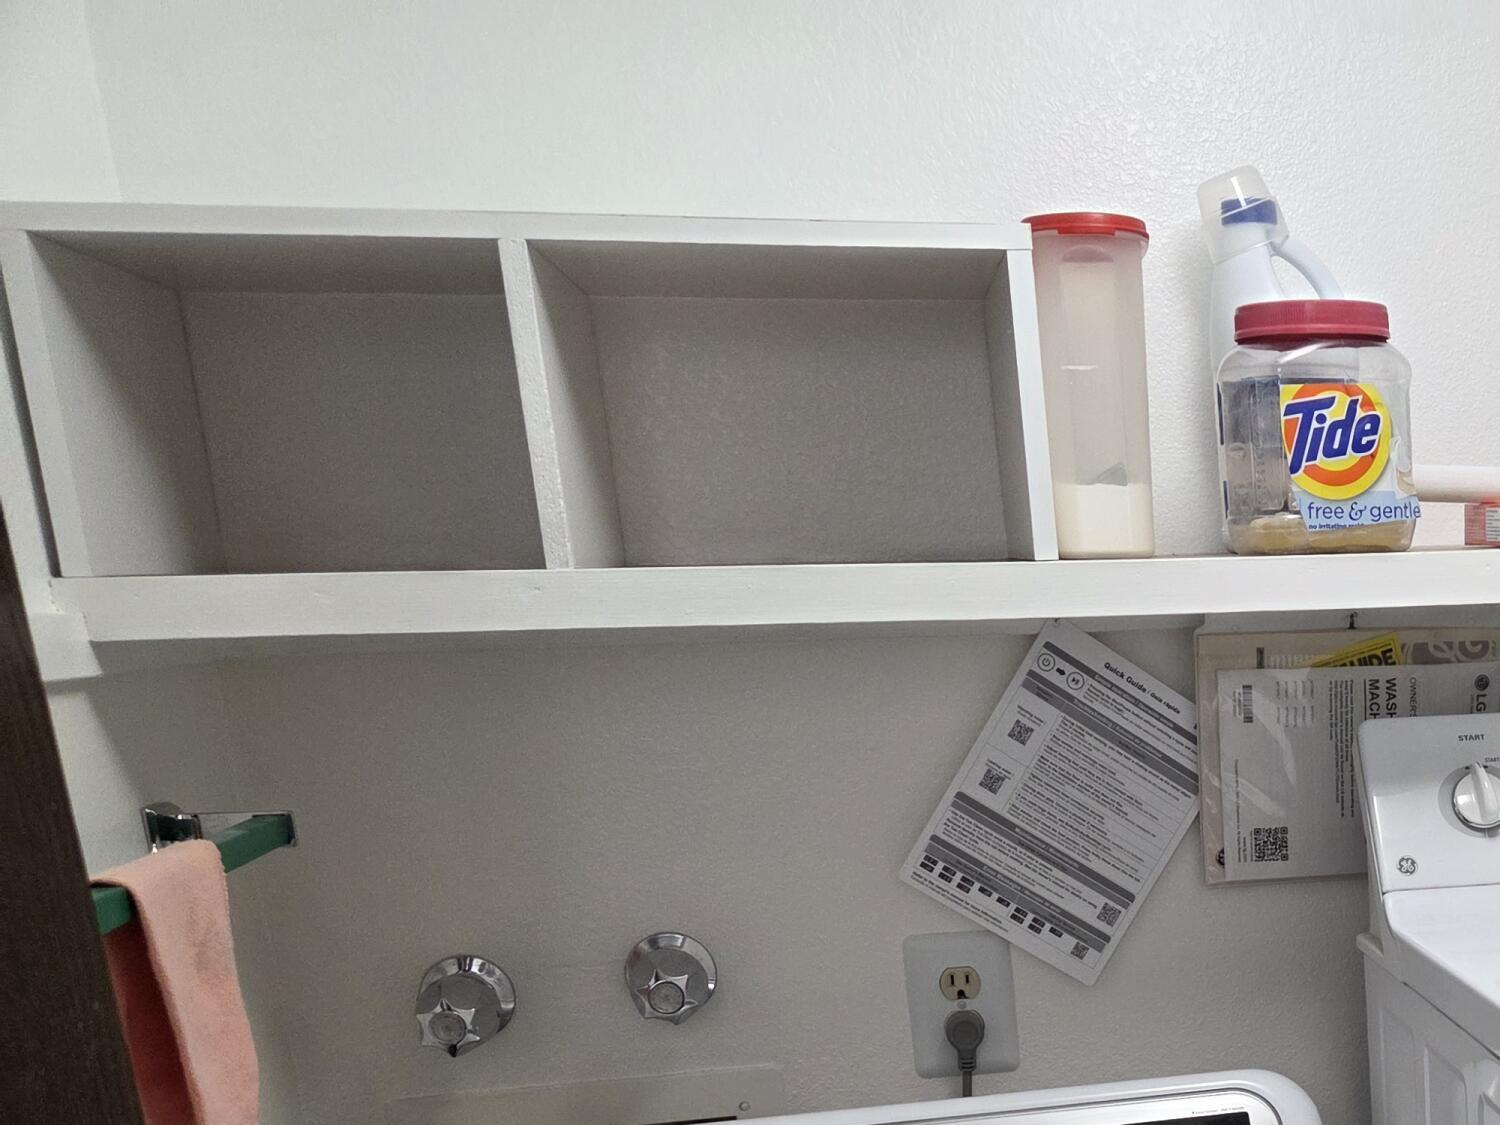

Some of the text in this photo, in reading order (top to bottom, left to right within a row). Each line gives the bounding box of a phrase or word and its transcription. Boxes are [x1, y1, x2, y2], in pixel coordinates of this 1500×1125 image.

[1283, 396, 1381, 475] Tide
[1307, 501, 1421, 522] free & gentle
[1104, 662, 1125, 679] Quick
[1126, 676, 1147, 693] Guide
[1476, 693, 1488, 712] LG
[1458, 733, 1485, 742] START
